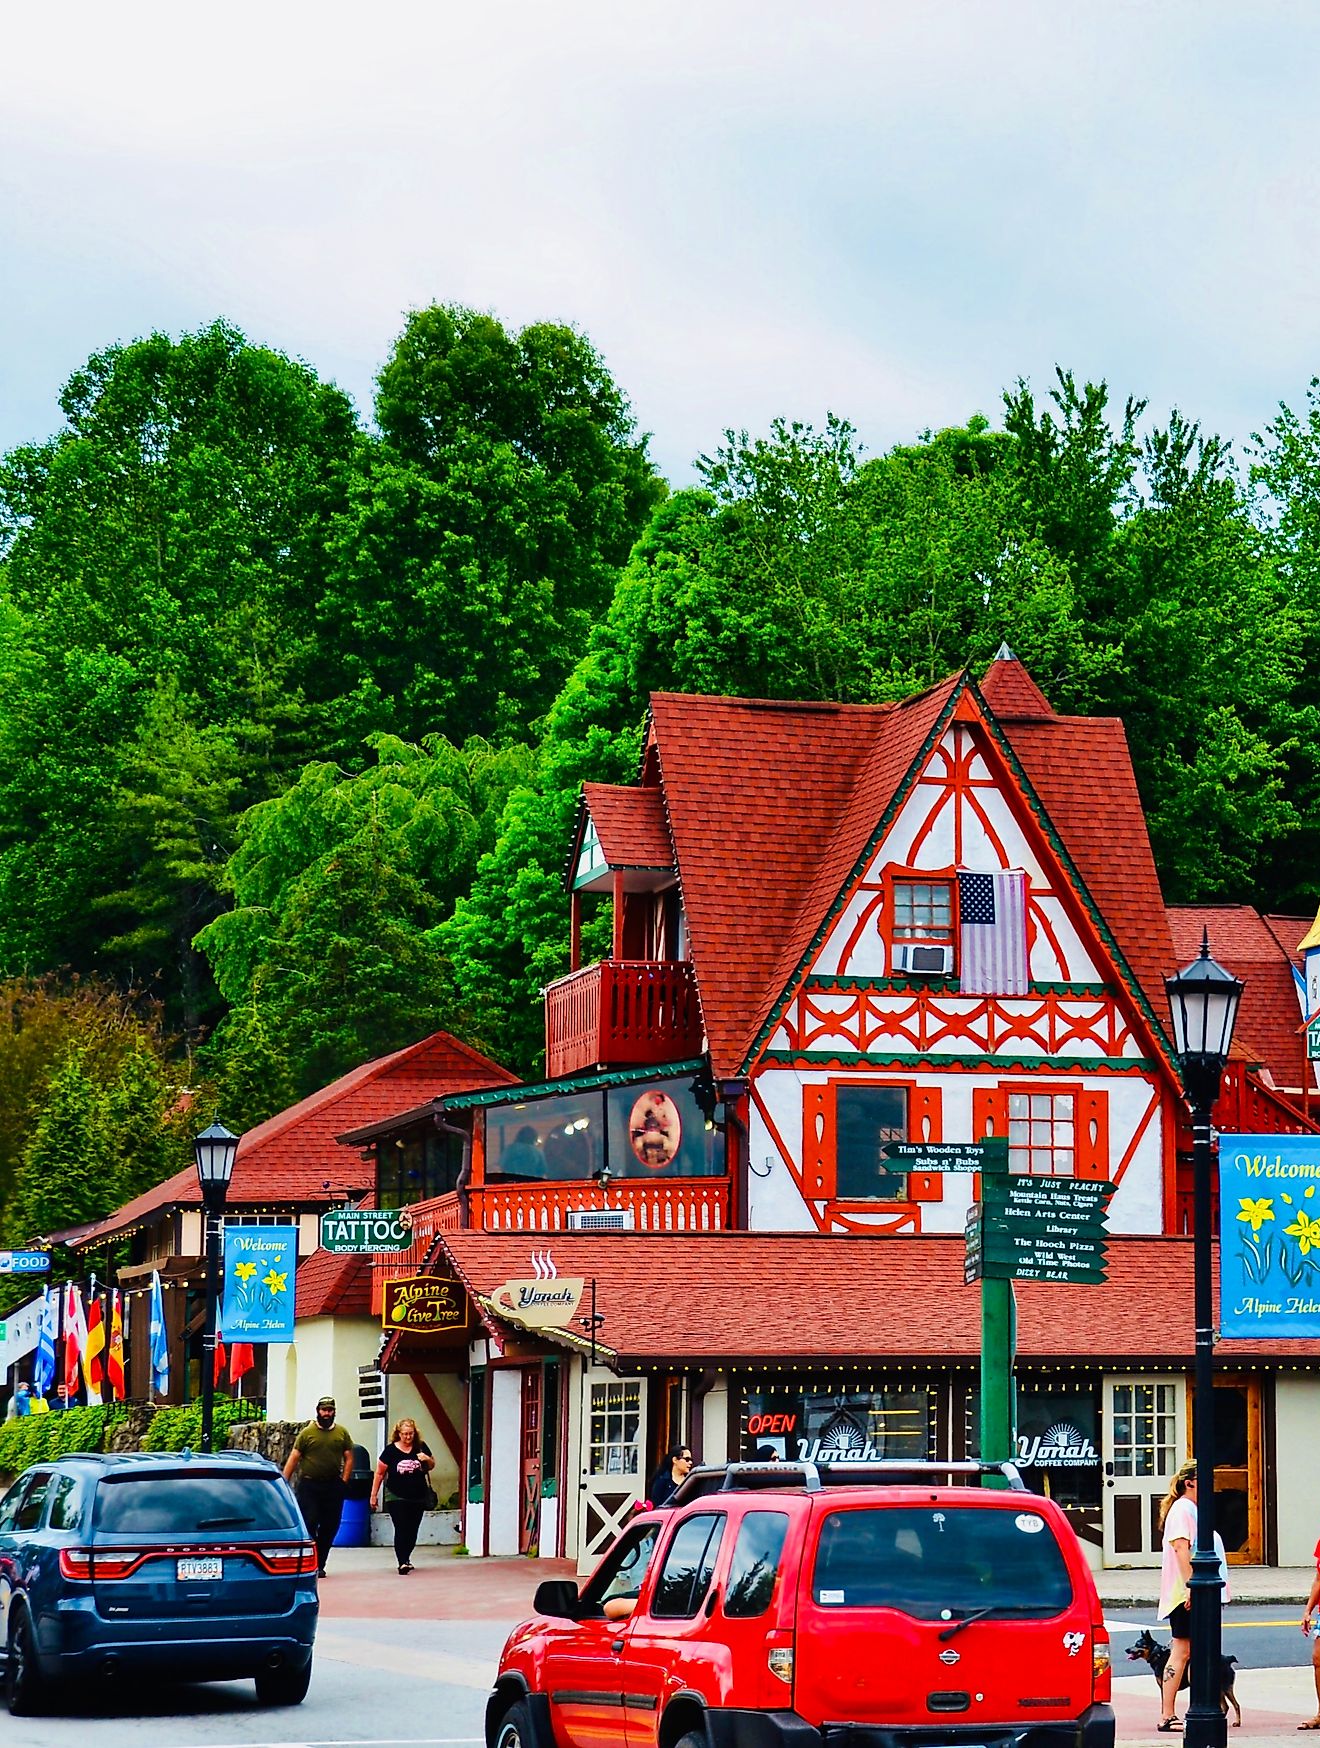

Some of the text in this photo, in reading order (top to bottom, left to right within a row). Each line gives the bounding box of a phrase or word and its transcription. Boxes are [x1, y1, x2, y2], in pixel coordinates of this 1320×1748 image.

[926, 1146, 962, 1154] Wooden
[965, 1146, 984, 1156] Toys
[1040, 1180, 1062, 1189] JUST
[1069, 1182, 1104, 1192] PEACHY
[1009, 1190, 1098, 1202] Mountain Haus Treats
[1004, 1208, 1090, 1220] Helen Arts Center
[324, 1220, 406, 1240] TATTOO
[1046, 1225, 1078, 1235] Library
[234, 1238, 288, 1251] Welcome
[1014, 1238, 1094, 1251] The Hooch Pizza
[12, 1257, 50, 1268] FOOD
[1034, 1252, 1076, 1261] Wild West
[1062, 1260, 1090, 1268] Photos
[1016, 1268, 1068, 1280] DIZZY BEAR
[394, 1283, 449, 1306] Alpine
[518, 1286, 576, 1308] Yonah
[426, 1300, 460, 1322] Tree
[1234, 1298, 1282, 1318] Alpine
[230, 1319, 285, 1330] Alpine Helen
[749, 1414, 796, 1434] OPEN
[797, 1438, 882, 1462] Yonah
[1018, 1436, 1098, 1468] Yonah
[181, 1562, 218, 1574] RTV3883
